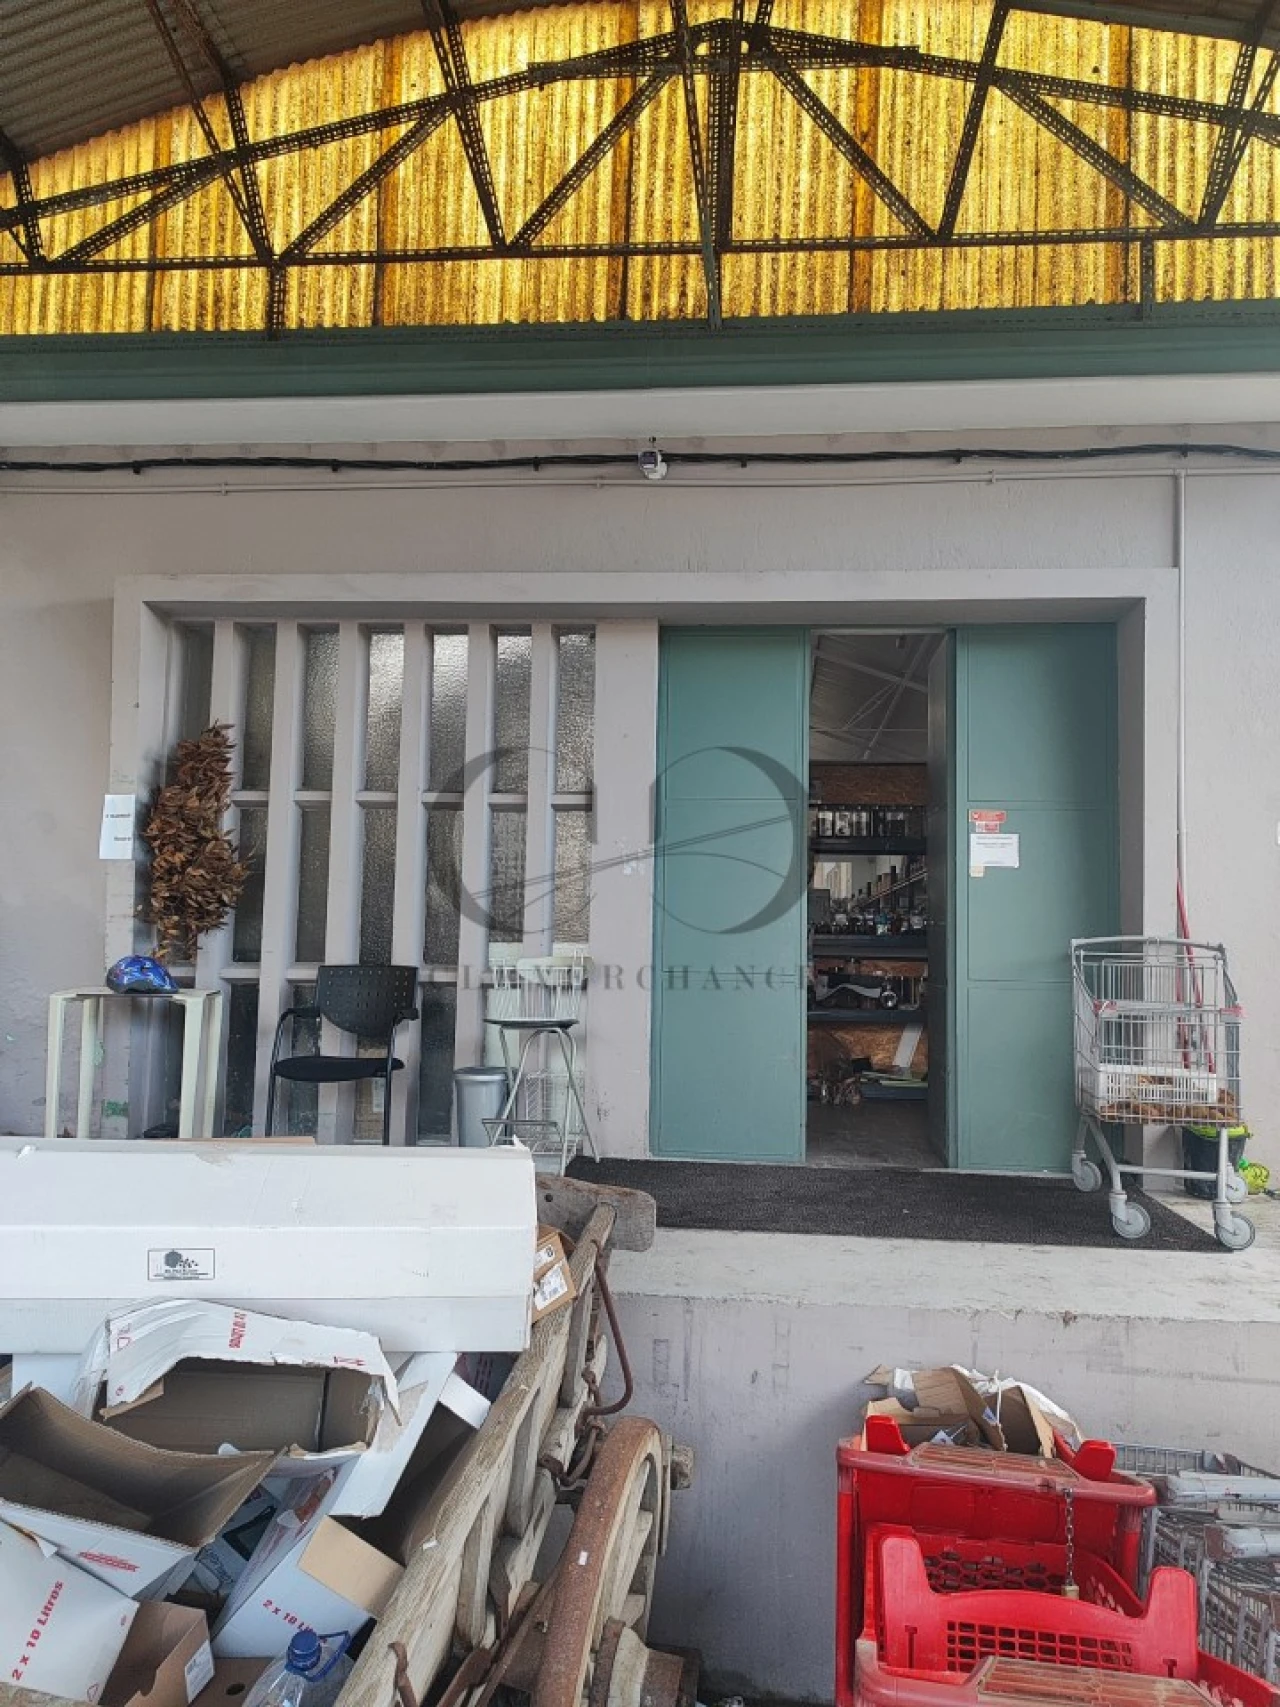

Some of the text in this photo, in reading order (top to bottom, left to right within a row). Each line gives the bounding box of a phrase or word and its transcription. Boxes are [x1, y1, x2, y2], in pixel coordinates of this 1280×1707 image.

[12, 1668, 23, 1680] 2
[26, 1628, 41, 1648] 10
[37, 1580, 63, 1626] Litros
[262, 1599, 273, 1608] 2
[282, 1612, 298, 1625] 10
